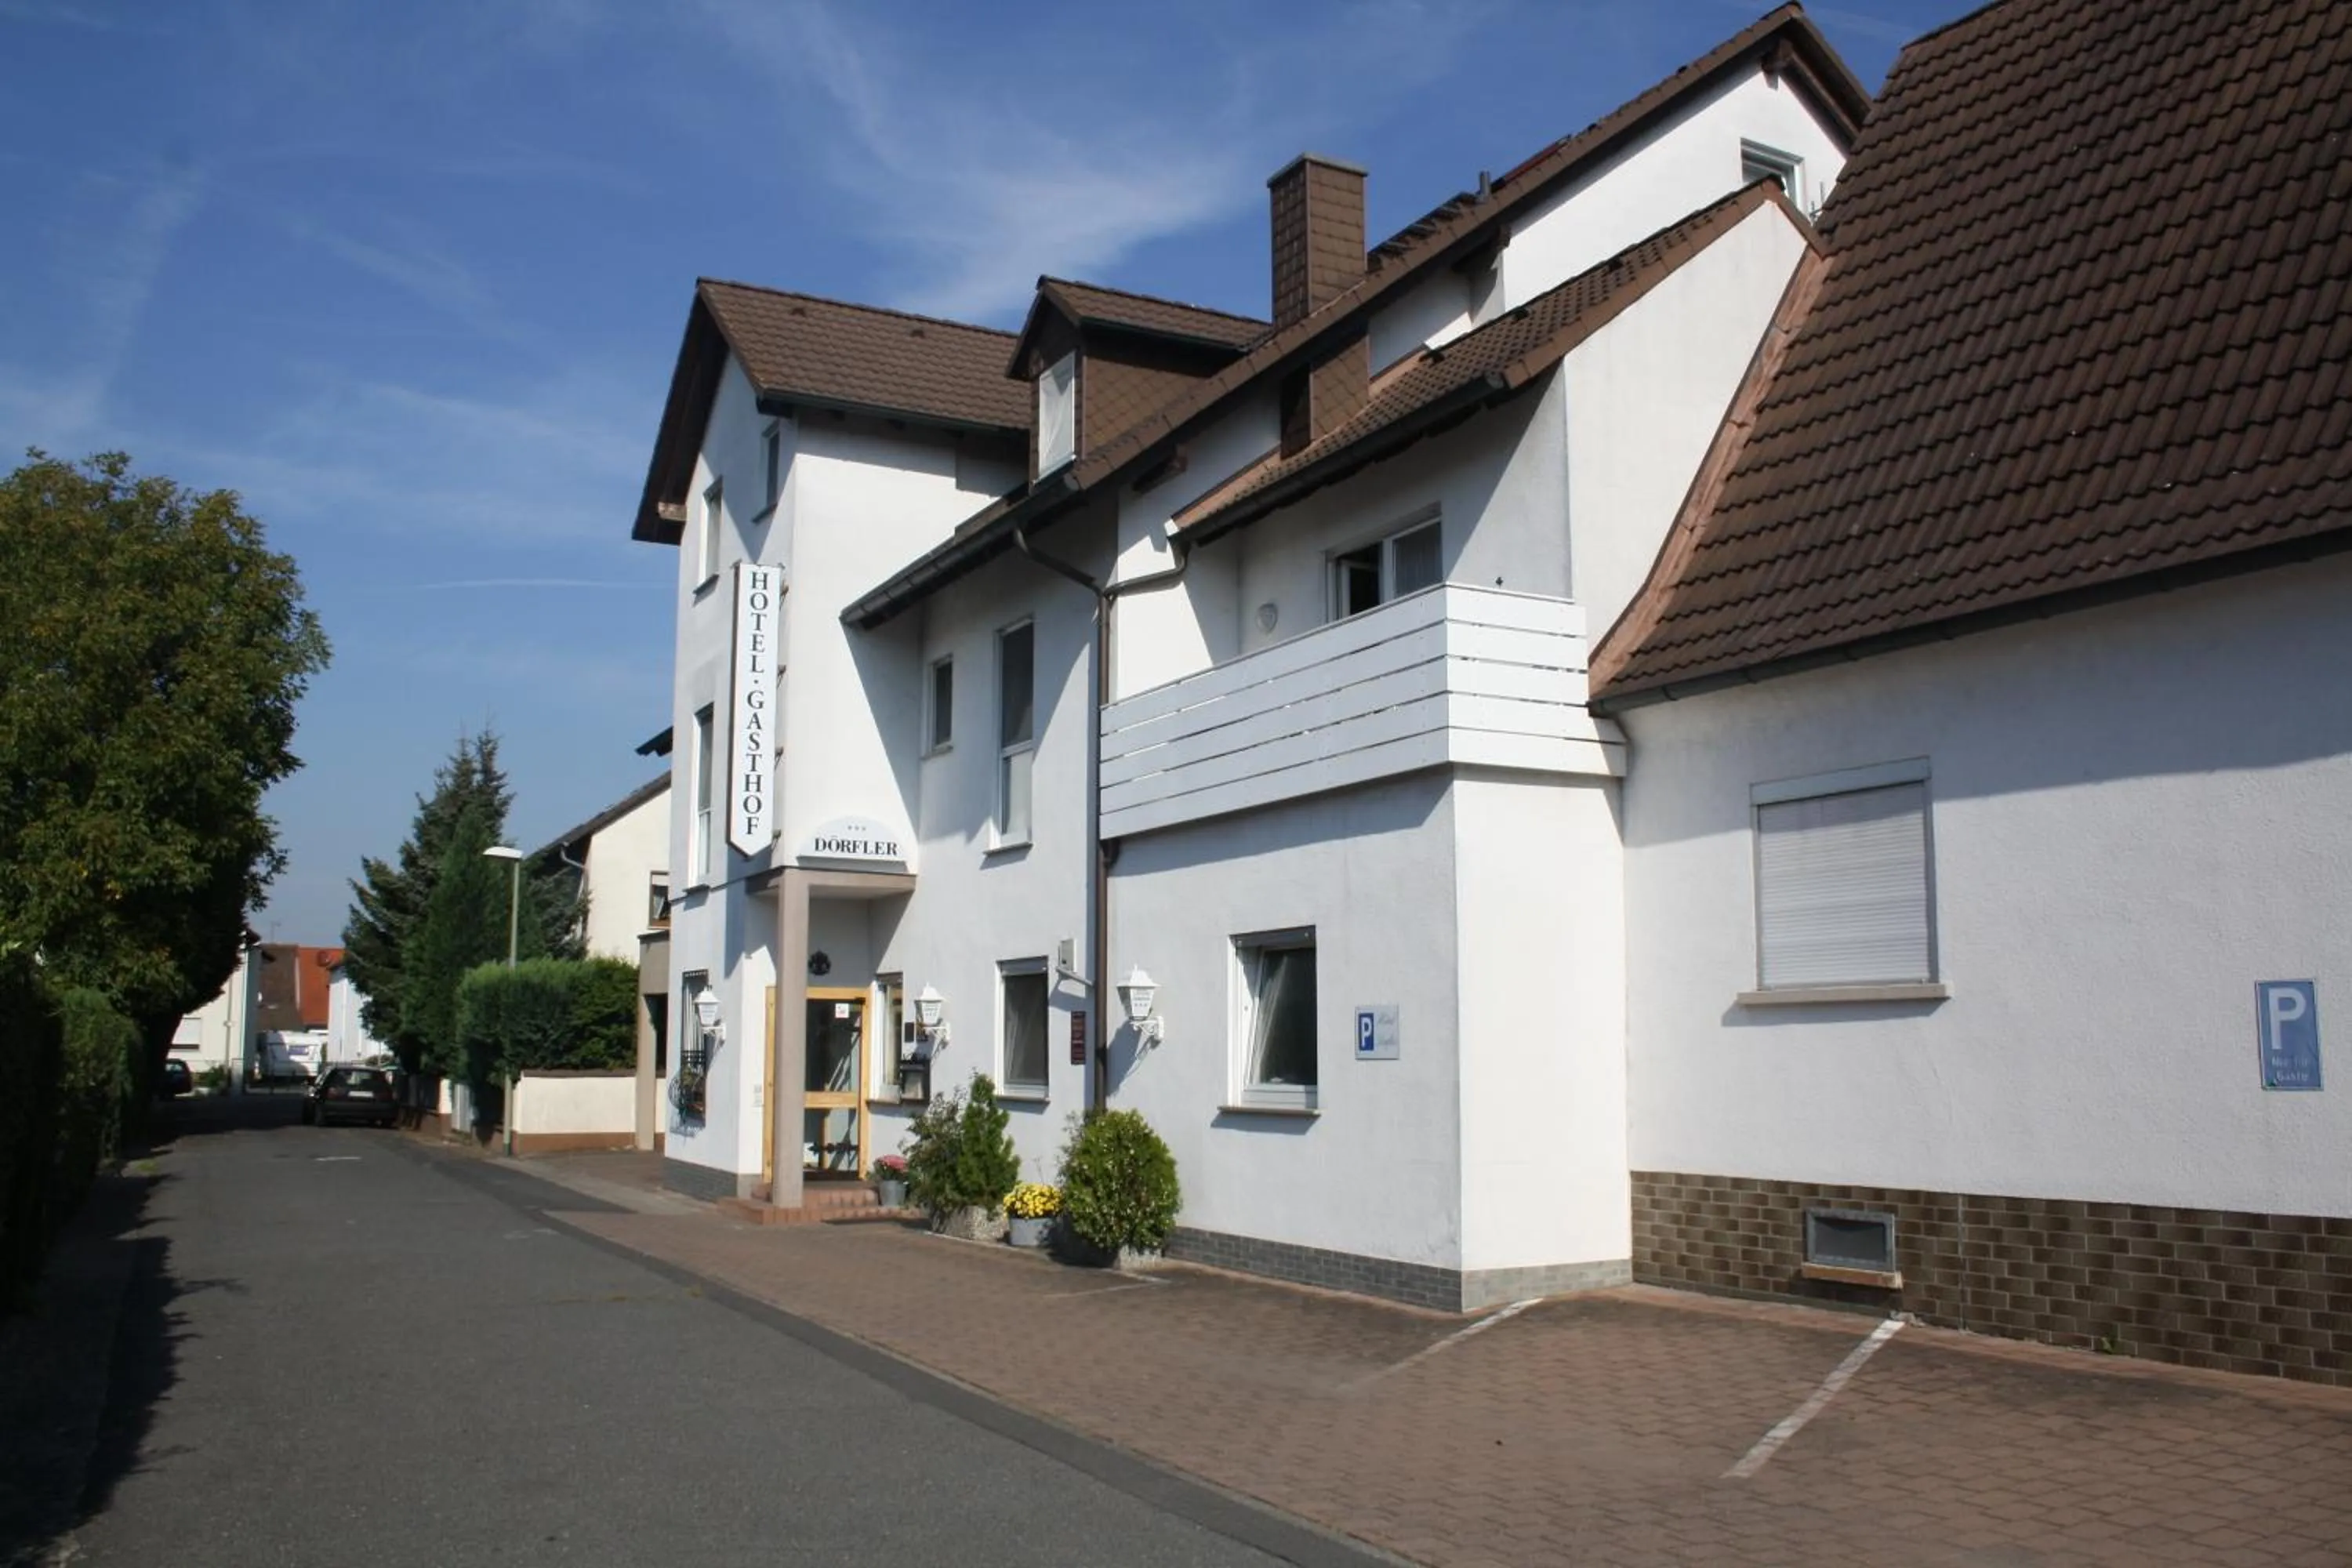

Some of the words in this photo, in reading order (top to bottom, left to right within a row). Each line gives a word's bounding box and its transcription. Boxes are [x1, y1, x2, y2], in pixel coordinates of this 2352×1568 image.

[749, 571, 768, 673] HOTEL
[742, 690, 766, 835] GASTHOF
[814, 836, 898, 856] DÖRFLER
[1361, 1017, 1372, 1047] P
[2268, 988, 2307, 1050] P
